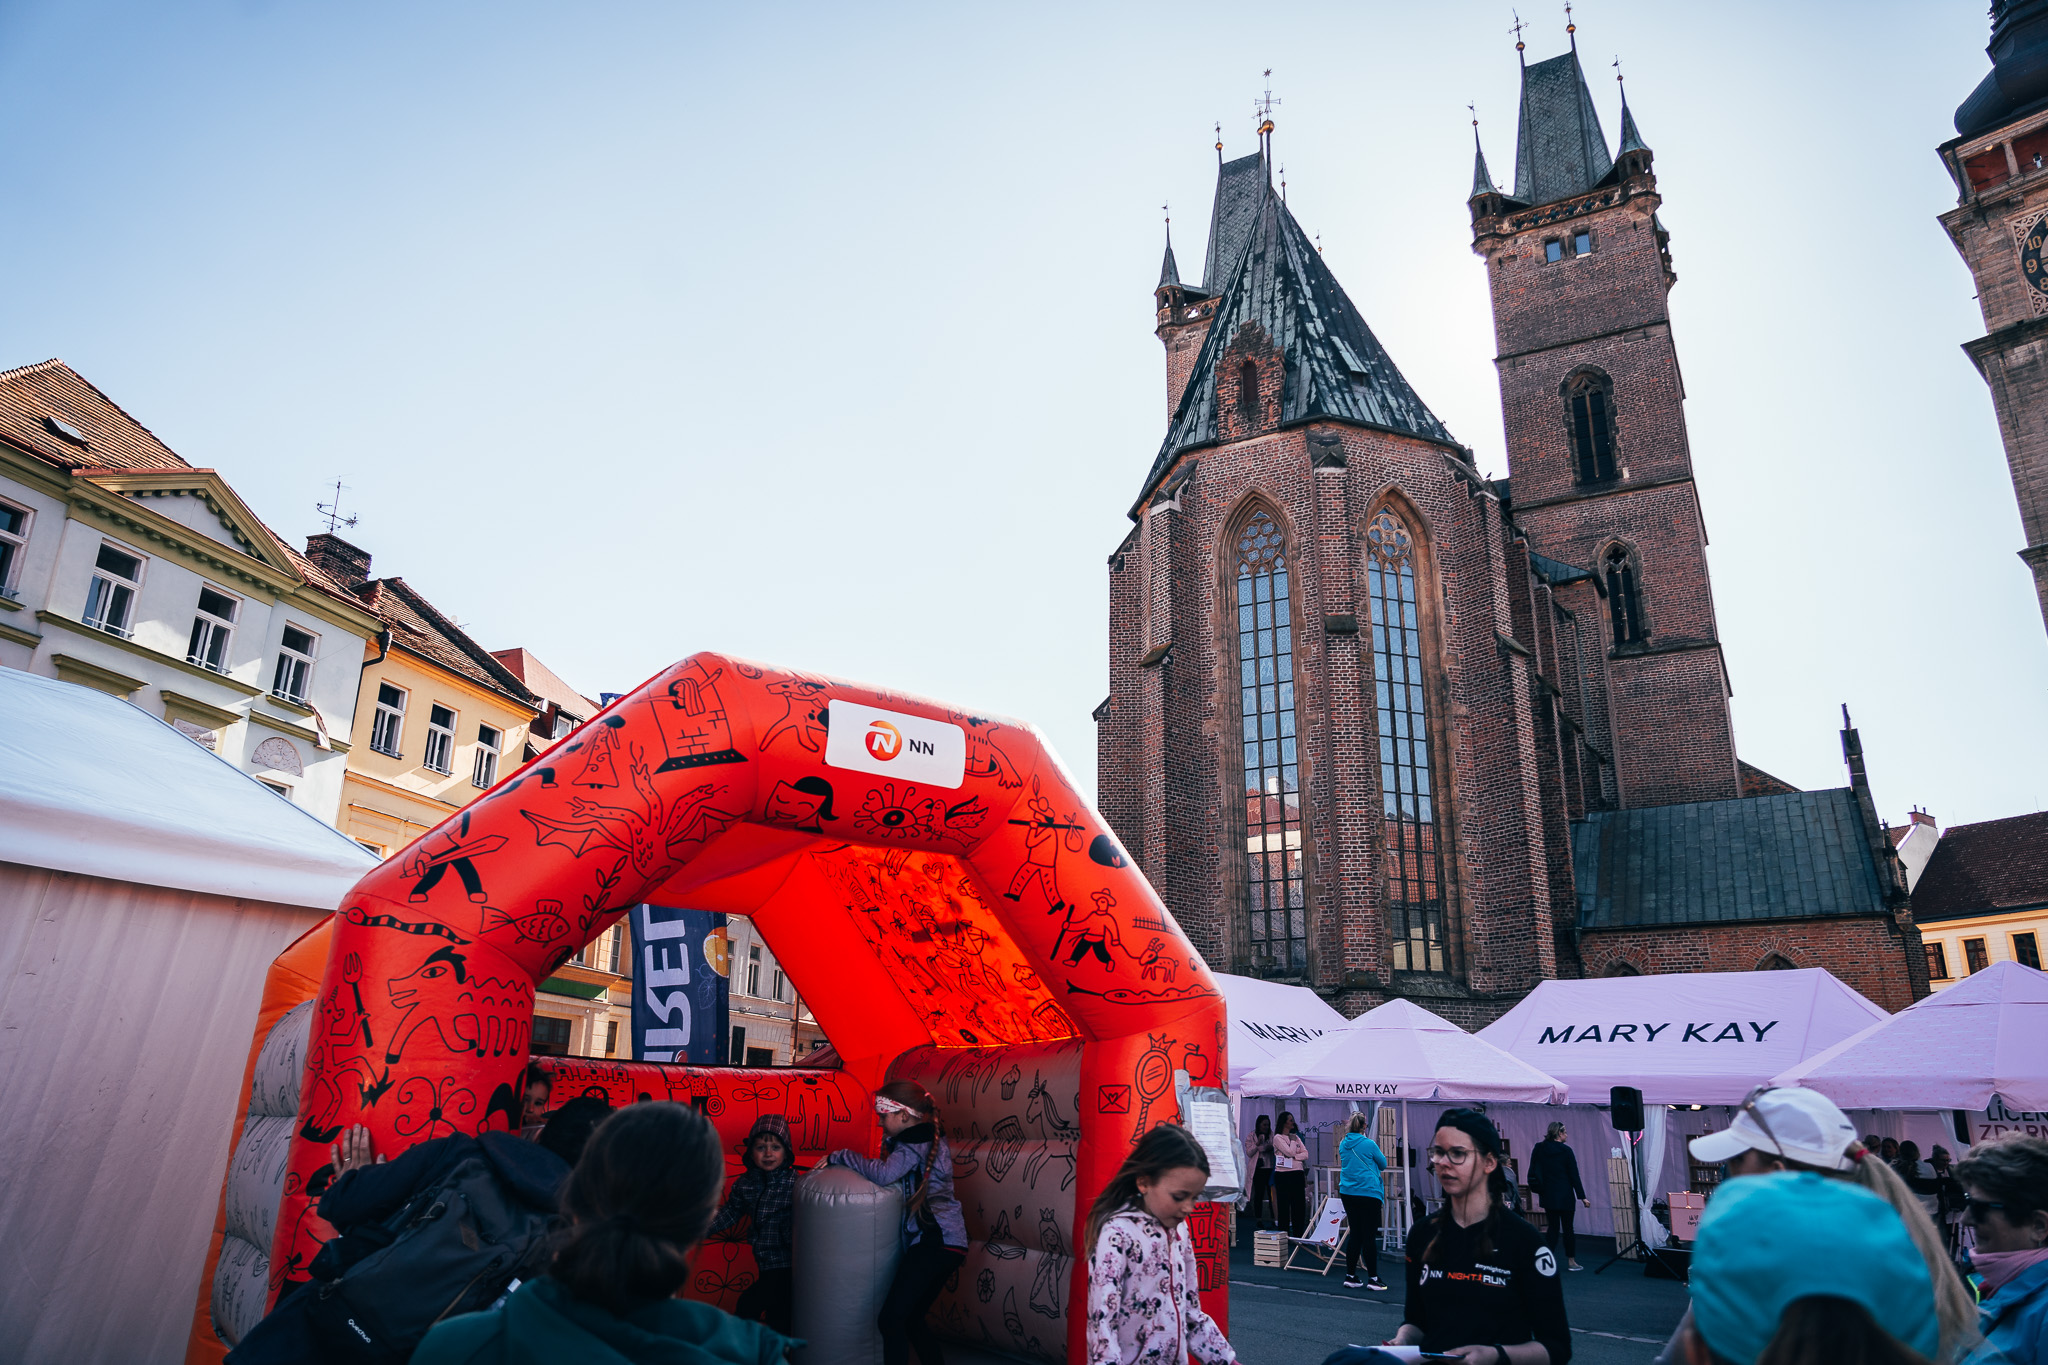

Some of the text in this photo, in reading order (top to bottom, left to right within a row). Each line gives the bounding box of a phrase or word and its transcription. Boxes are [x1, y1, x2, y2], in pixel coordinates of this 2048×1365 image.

[2028, 235, 2042, 251] 10
[2026, 258, 2038, 274] 9
[909, 738, 934, 756] NN
[1239, 1019, 1313, 1044] MARY
[1537, 1020, 1779, 1044] MARY KAY
[1335, 1083, 1398, 1095] MARY KAY
[1429, 1270, 1443, 1278] NN
[1482, 1274, 1506, 1286] RUN
